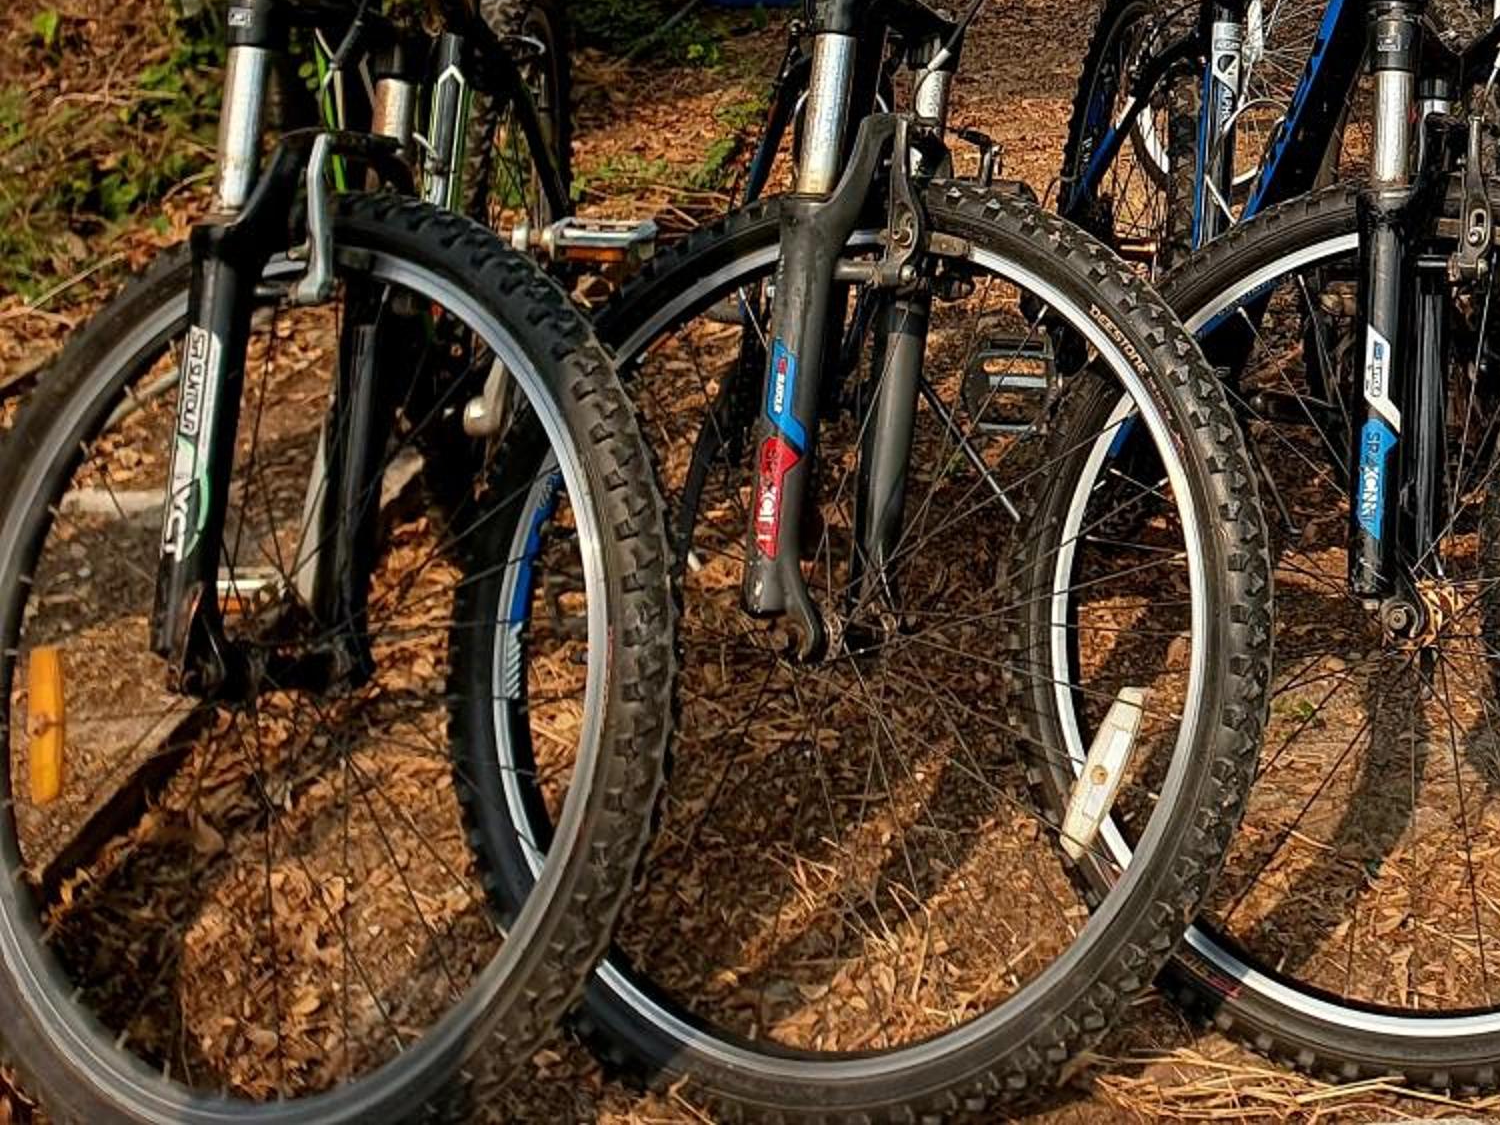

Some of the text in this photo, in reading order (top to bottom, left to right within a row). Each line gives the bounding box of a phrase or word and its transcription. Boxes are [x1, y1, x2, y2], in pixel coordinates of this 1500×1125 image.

[1089, 303, 1151, 375] DEESTONE
[181, 328, 208, 433] SR SUNTOUR
[162, 487, 191, 563] XCT
